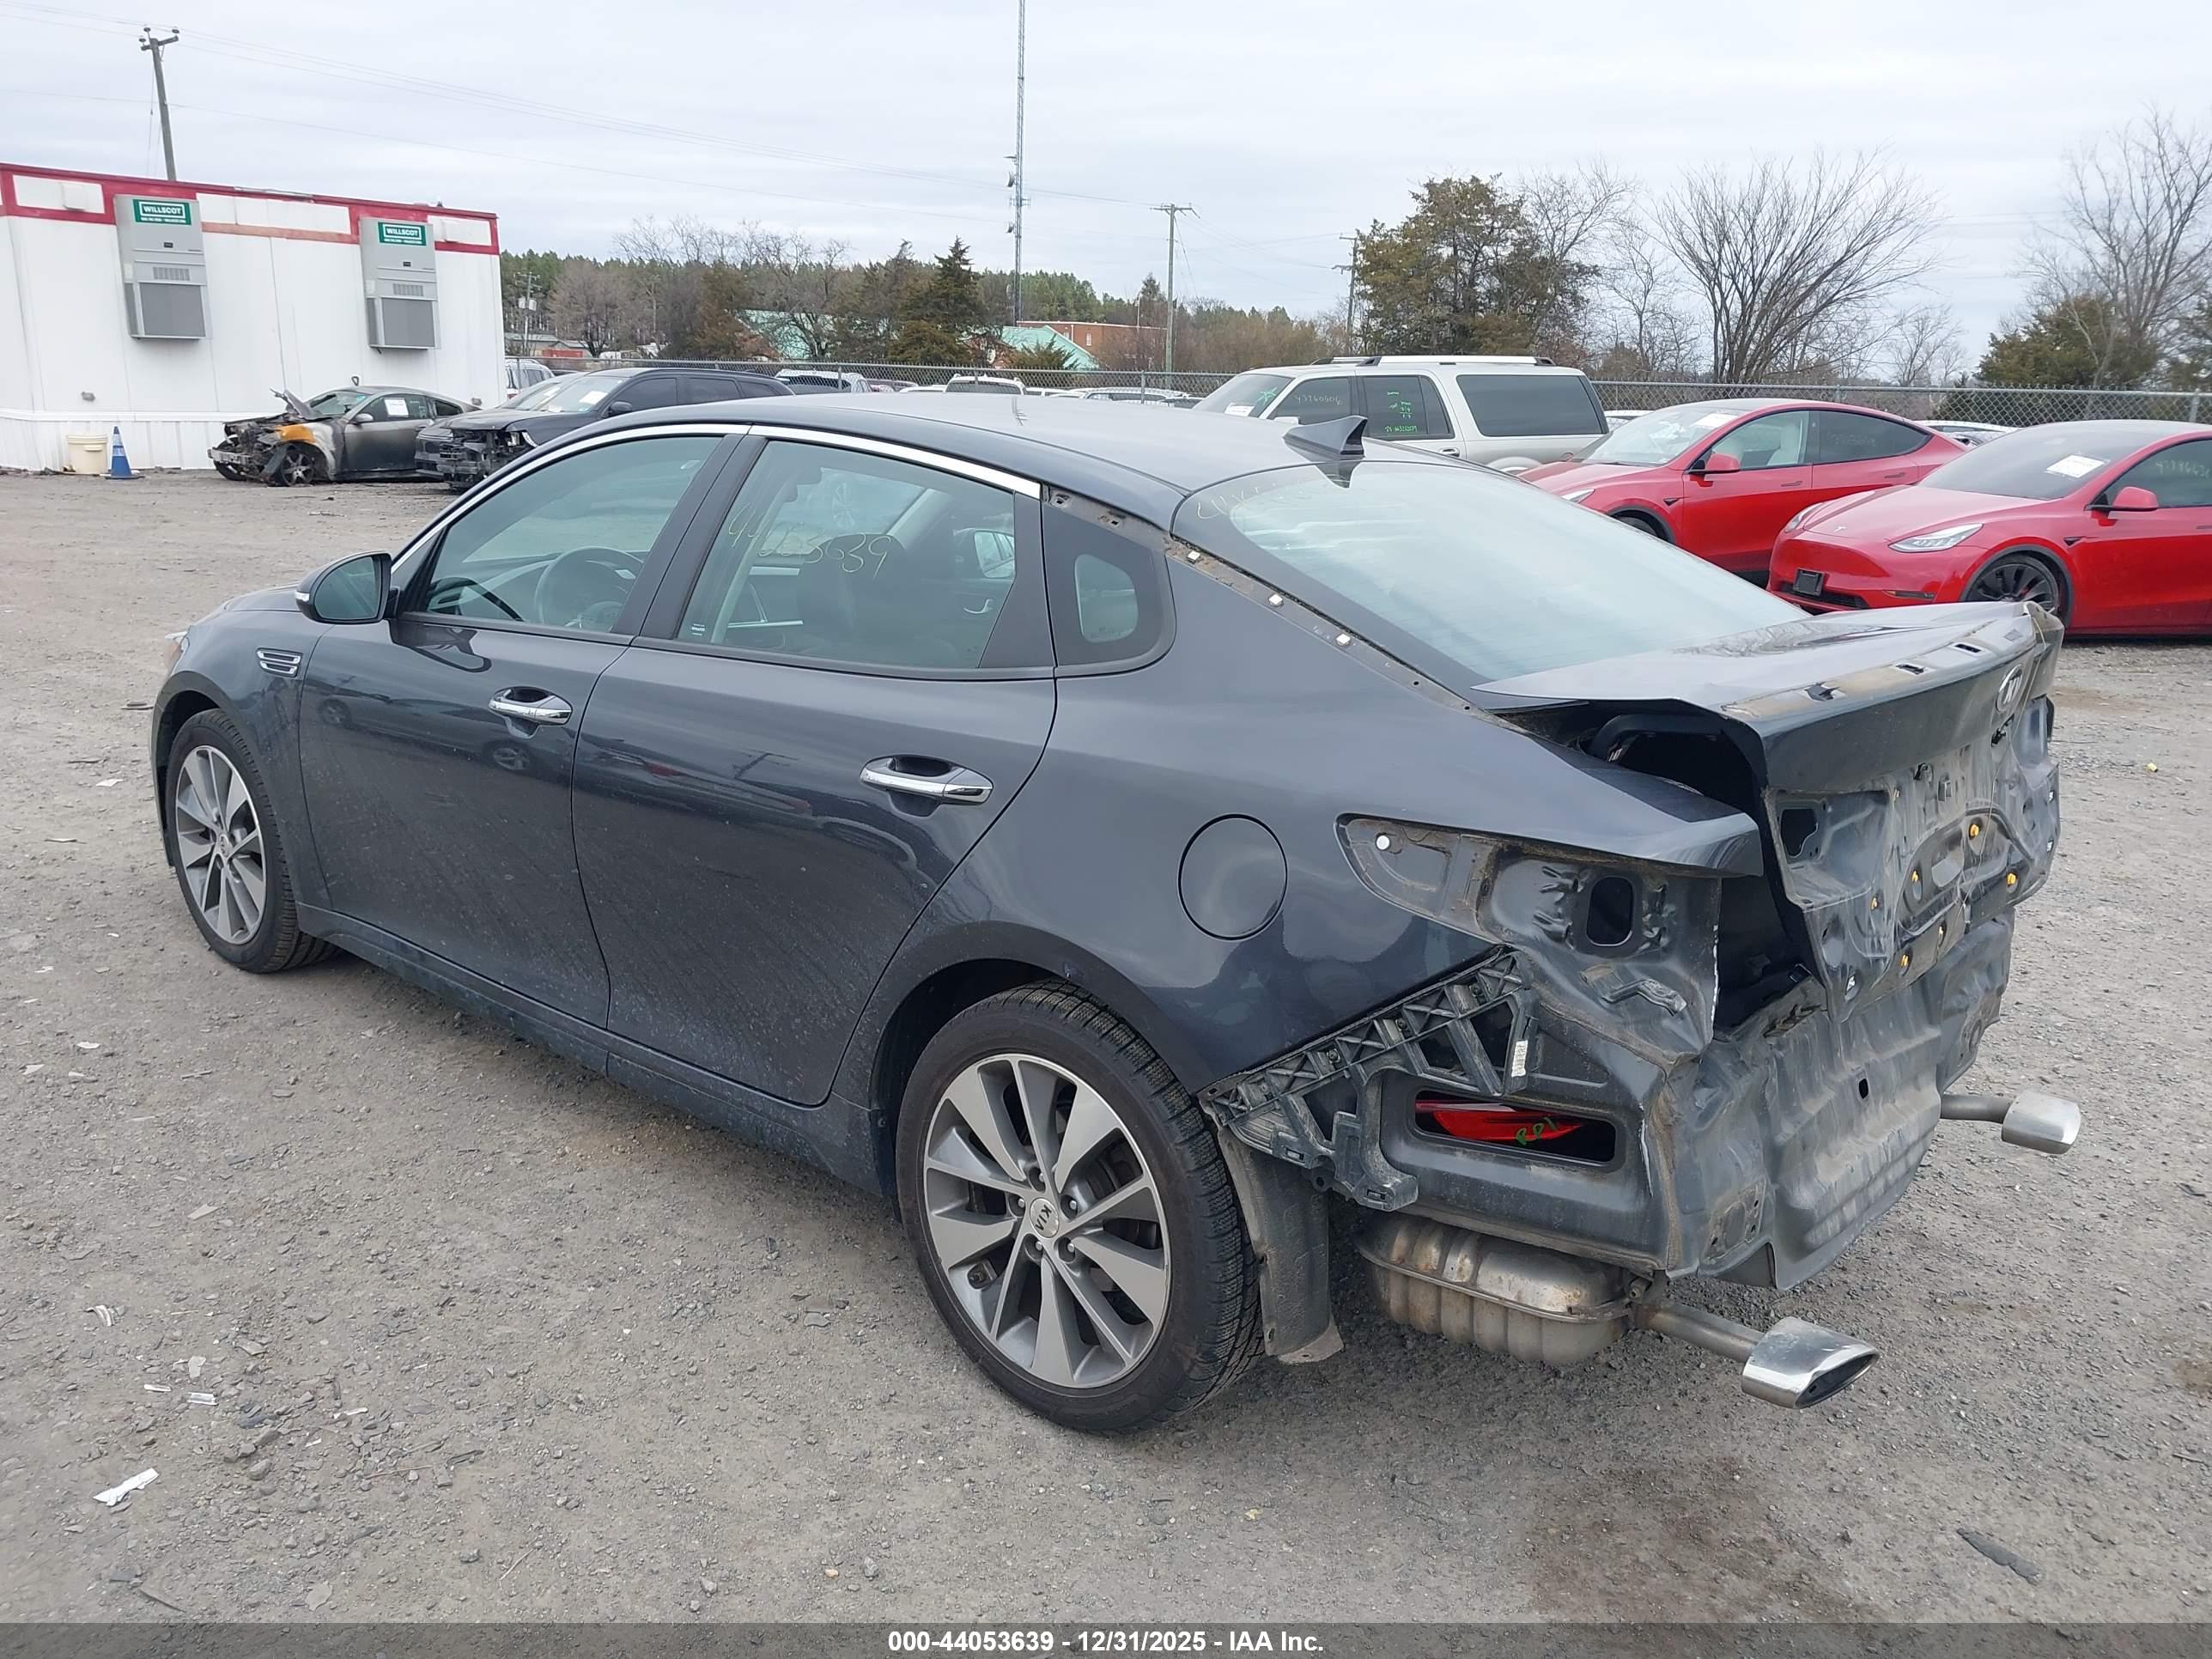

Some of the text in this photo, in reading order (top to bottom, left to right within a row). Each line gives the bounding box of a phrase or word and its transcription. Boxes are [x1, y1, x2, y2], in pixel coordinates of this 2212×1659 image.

[143, 205, 182, 215] WILLSCOT
[386, 228, 419, 237] WILLSCOT
[1035, 1204, 1053, 1231] KIA
